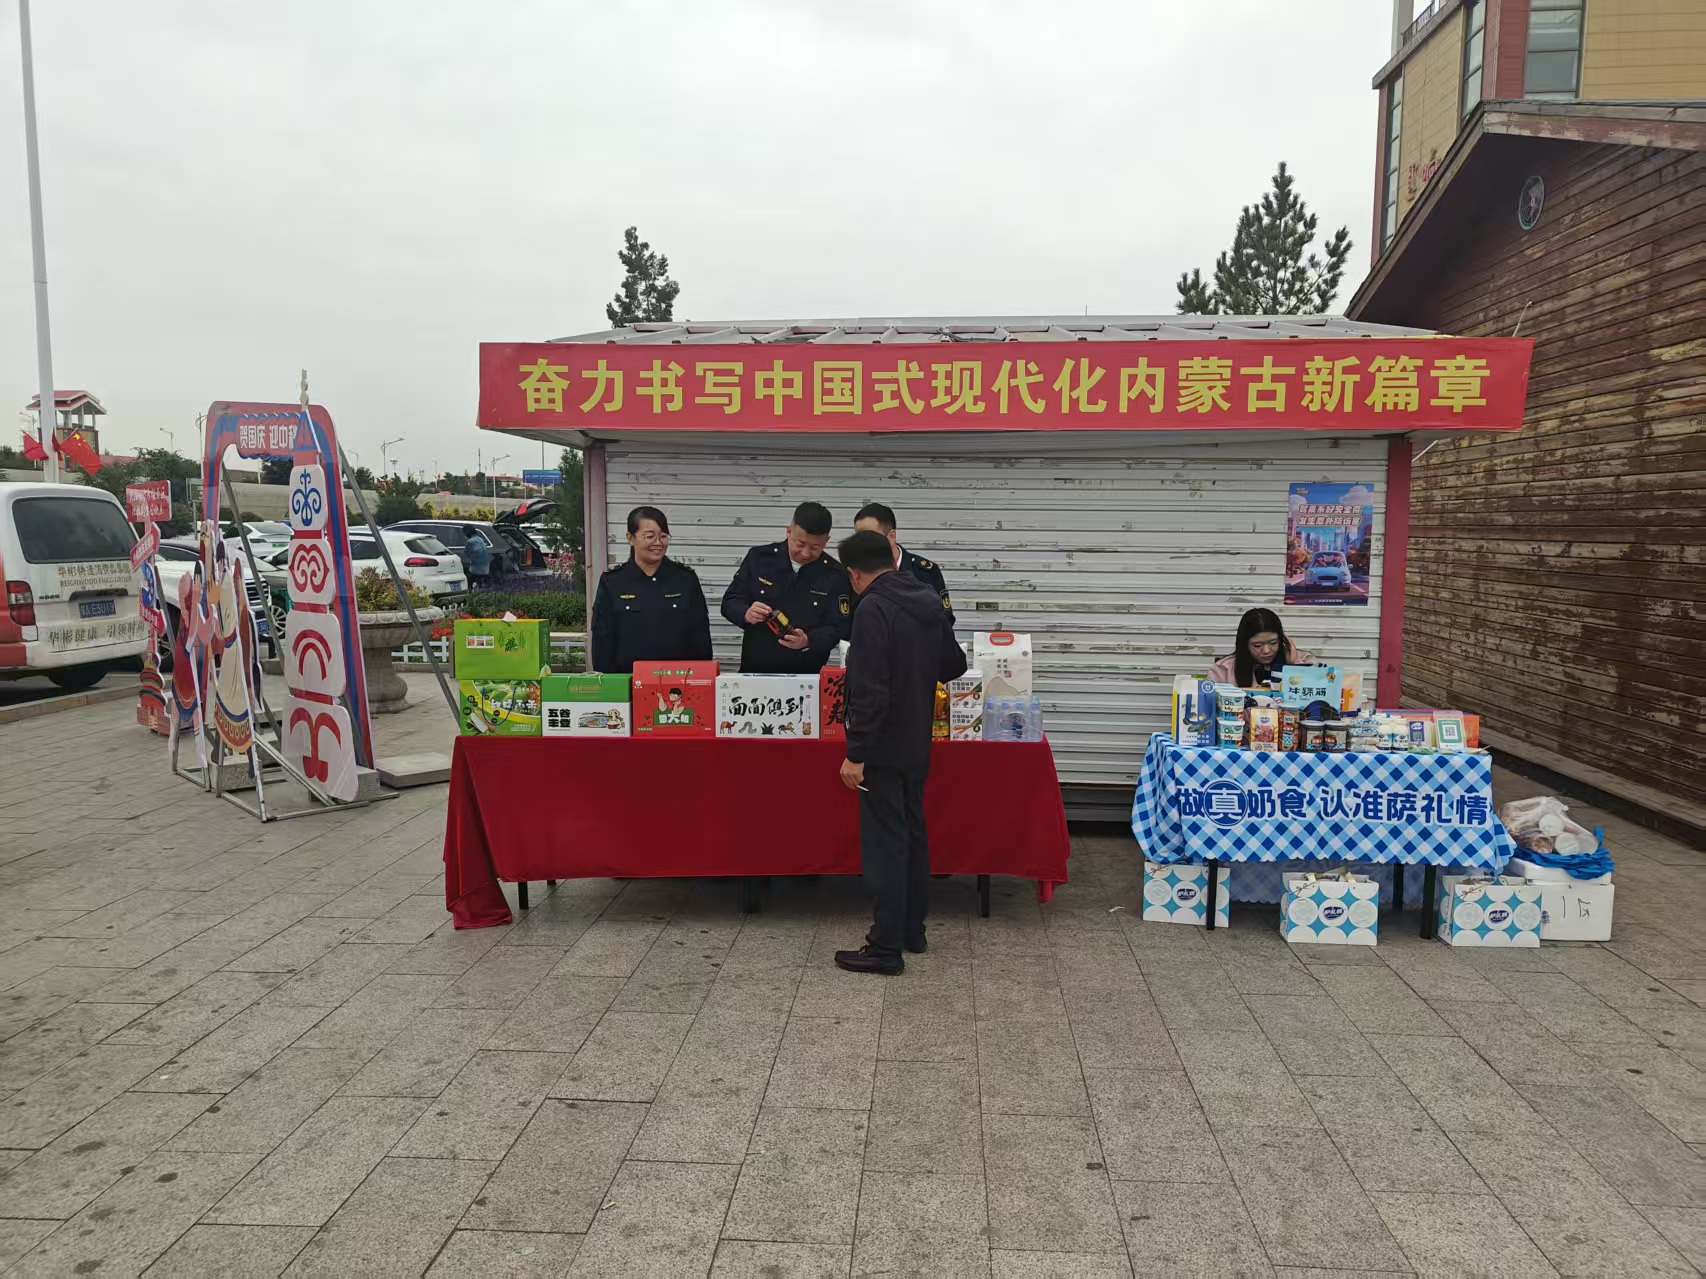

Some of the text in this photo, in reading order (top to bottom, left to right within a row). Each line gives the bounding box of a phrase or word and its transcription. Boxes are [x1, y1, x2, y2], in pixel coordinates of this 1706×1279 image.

[519, 354, 1491, 416] 奋力书写中国式现代化内蒙古新篇章
[240, 425, 266, 449] 贺国庆
[1297, 515, 1362, 527] 发生意外防伤害
[1288, 686, 1327, 697] 牛蹄筋
[548, 708, 571, 718] 五谷
[728, 695, 804, 724] 面面俱到
[548, 718, 571, 728] 丰登
[1176, 782, 1487, 826] 做真奶食 认准萨礼情
